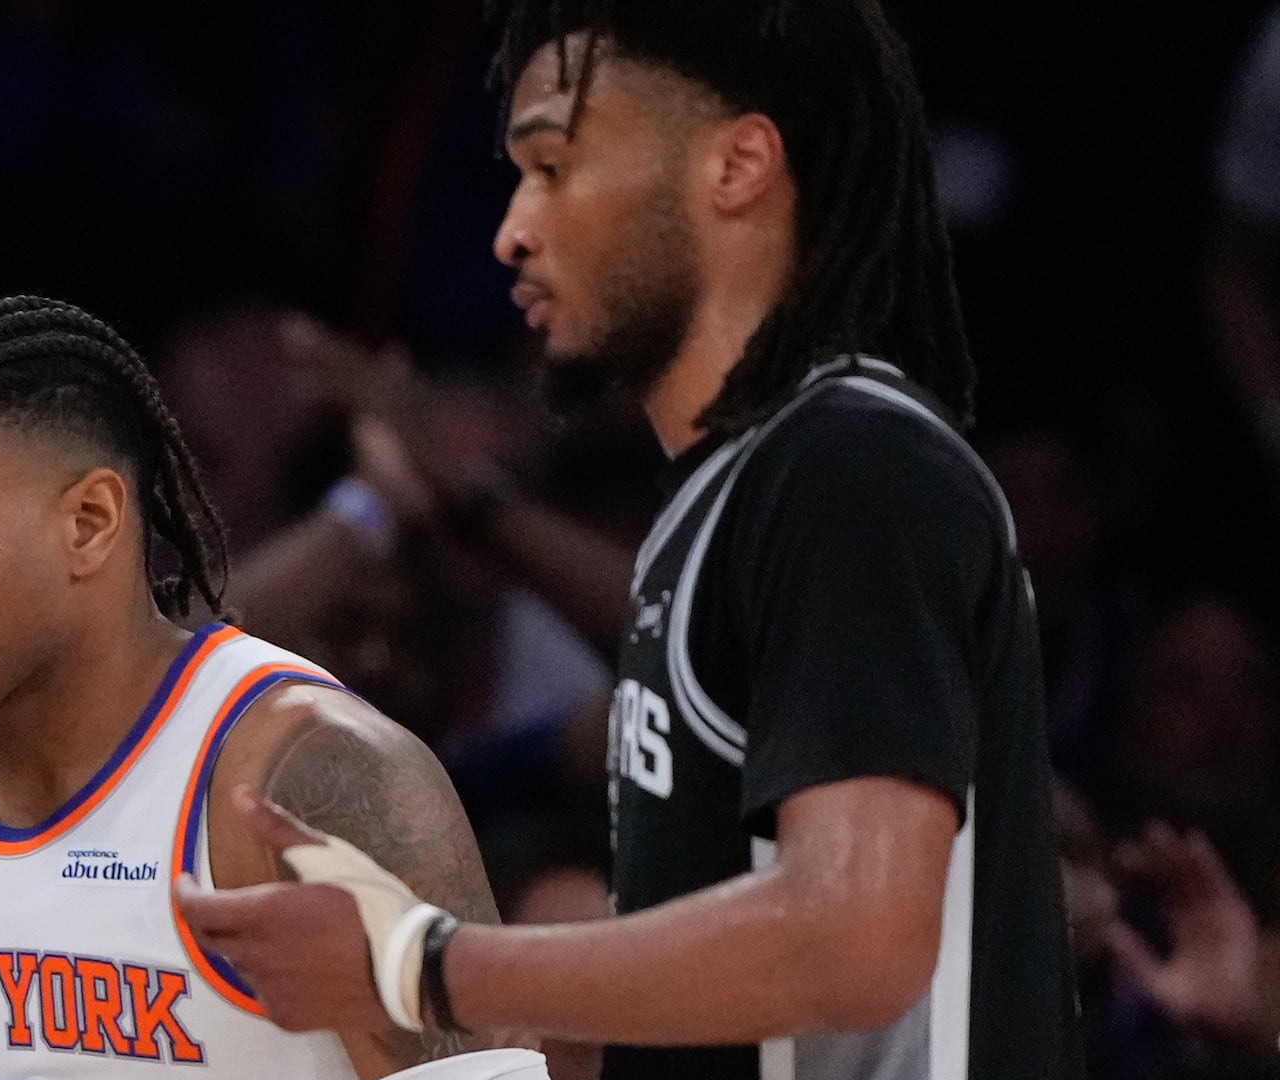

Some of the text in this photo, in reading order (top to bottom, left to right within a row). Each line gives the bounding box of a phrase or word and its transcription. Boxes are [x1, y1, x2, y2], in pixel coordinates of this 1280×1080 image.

[607, 678, 674, 801] RS
[62, 860, 159, 881] abu dhabi
